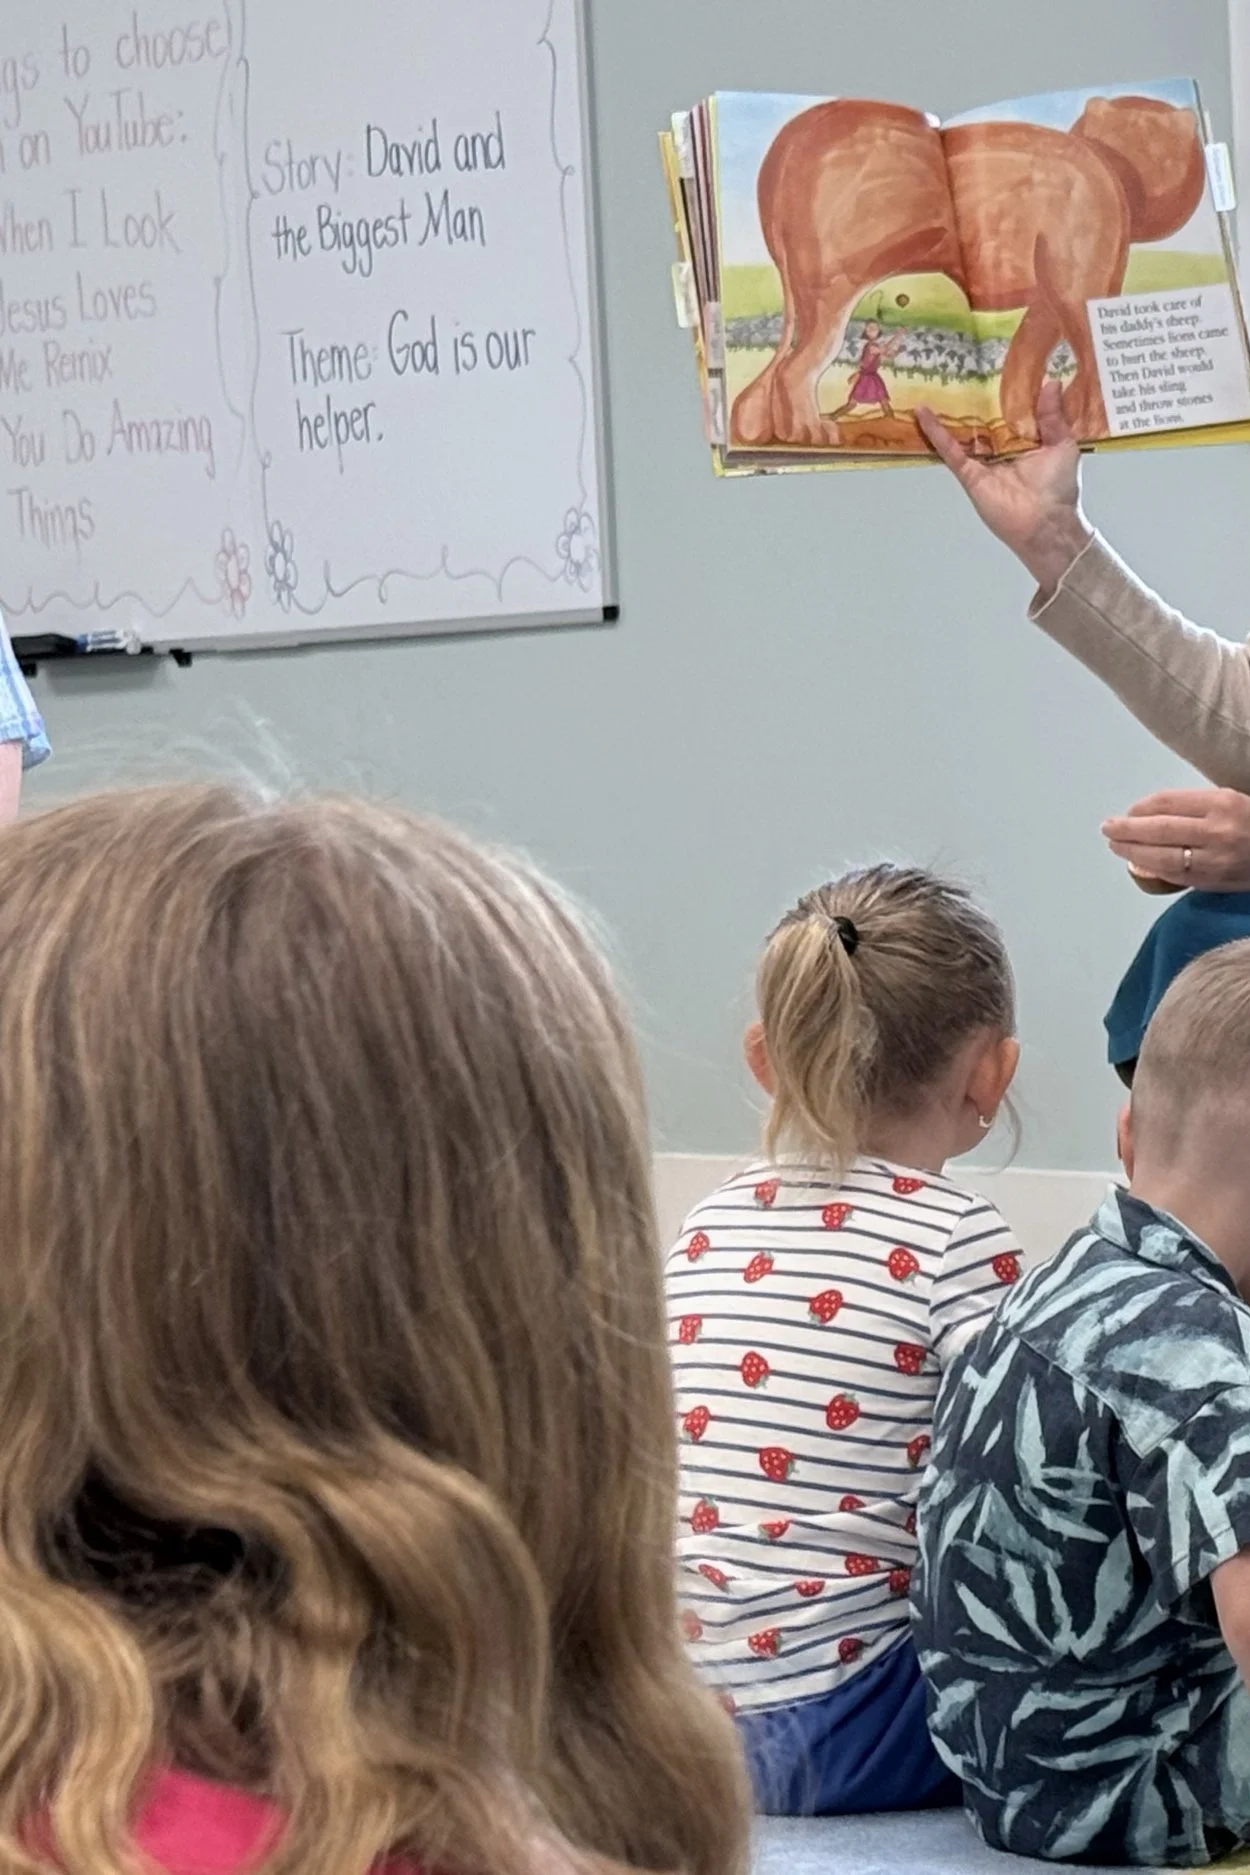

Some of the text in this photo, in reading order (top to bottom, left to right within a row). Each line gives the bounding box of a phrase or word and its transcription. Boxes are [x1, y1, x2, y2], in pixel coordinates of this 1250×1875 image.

[59, 23, 90, 78] to
[116, 10, 229, 69] choose
[63, 87, 188, 159] YouTube:
[261, 110, 506, 194] Story: David and
[61, 187, 85, 248] I
[101, 187, 183, 254] Look
[271, 188, 487, 279] the Biggest Man
[76, 270, 157, 321] Loves
[1097, 294, 1202, 319] David took care of
[280, 309, 537, 387] Theme: God is our
[1100, 323, 1118, 335] his
[1102, 326, 1229, 351] Sometimes lions came
[42, 336, 113, 389] Remix
[1106, 356, 1119, 367] to
[1121, 352, 1146, 366] hurt
[1148, 348, 1168, 361] the
[1109, 359, 1214, 383] Then David would
[1111, 387, 1137, 399] take
[1138, 382, 1157, 396] his
[1115, 393, 1214, 415] and throw stones
[0, 398, 216, 481] You Do Amazing
[296, 393, 384, 475] helper.
[1119, 420, 1129, 430] at
[1131, 415, 1151, 428] the
[7, 484, 96, 562] Things
